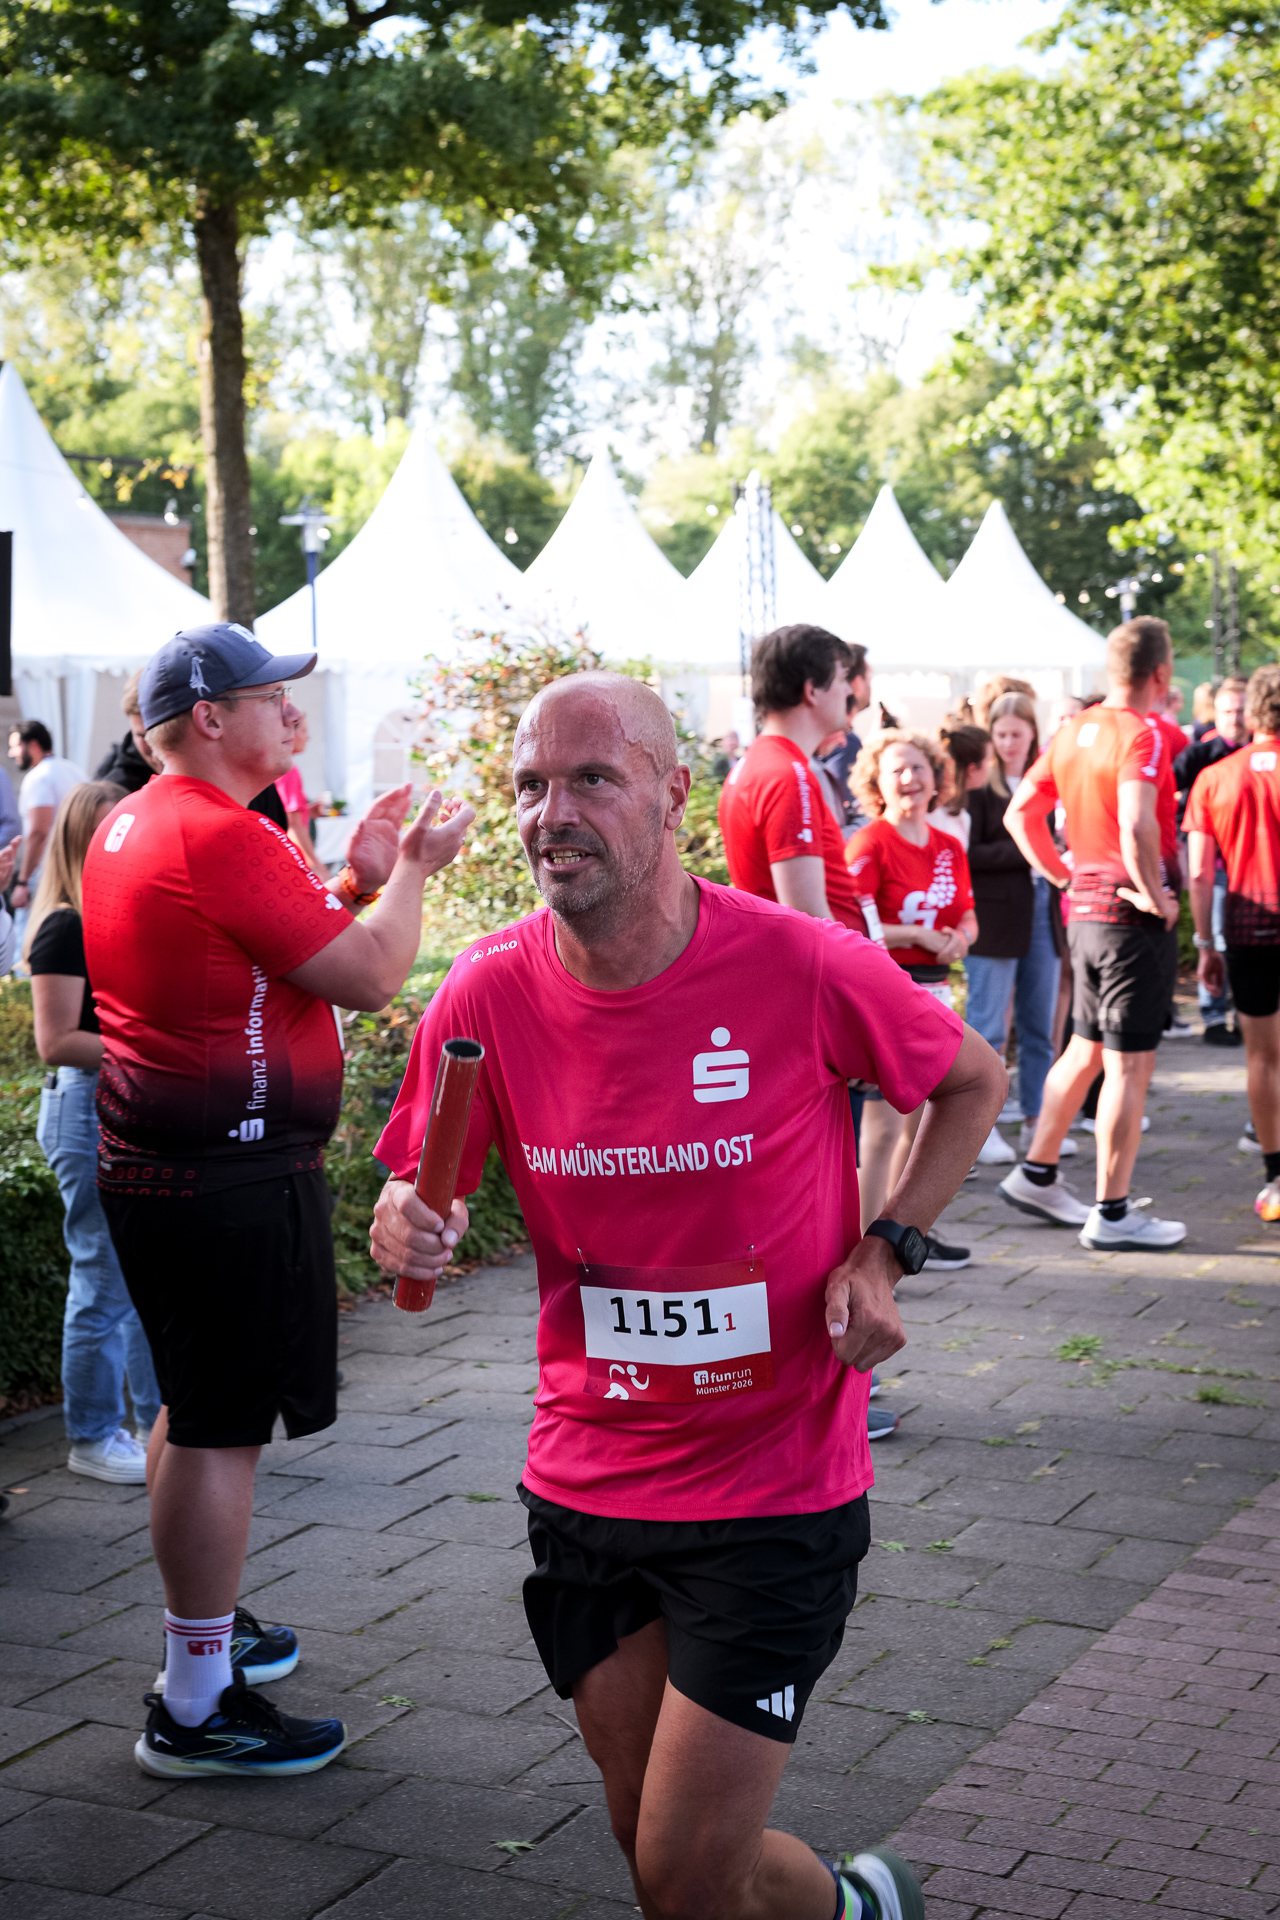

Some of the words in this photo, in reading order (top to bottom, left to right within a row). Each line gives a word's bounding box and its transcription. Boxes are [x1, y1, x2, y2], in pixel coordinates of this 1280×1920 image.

[486, 940, 518, 956] JAKO
[246, 1058, 267, 1110] finanz
[521, 1141, 558, 1176] EAM
[560, 1142, 709, 1177] MÜNSTERLAND
[714, 1133, 754, 1169] OST
[609, 1296, 719, 1338] 1151
[723, 1312, 737, 1332] 1
[696, 1384, 731, 1396] Münster
[732, 1378, 753, 1390] 2026
[710, 1368, 752, 1384] funrun
